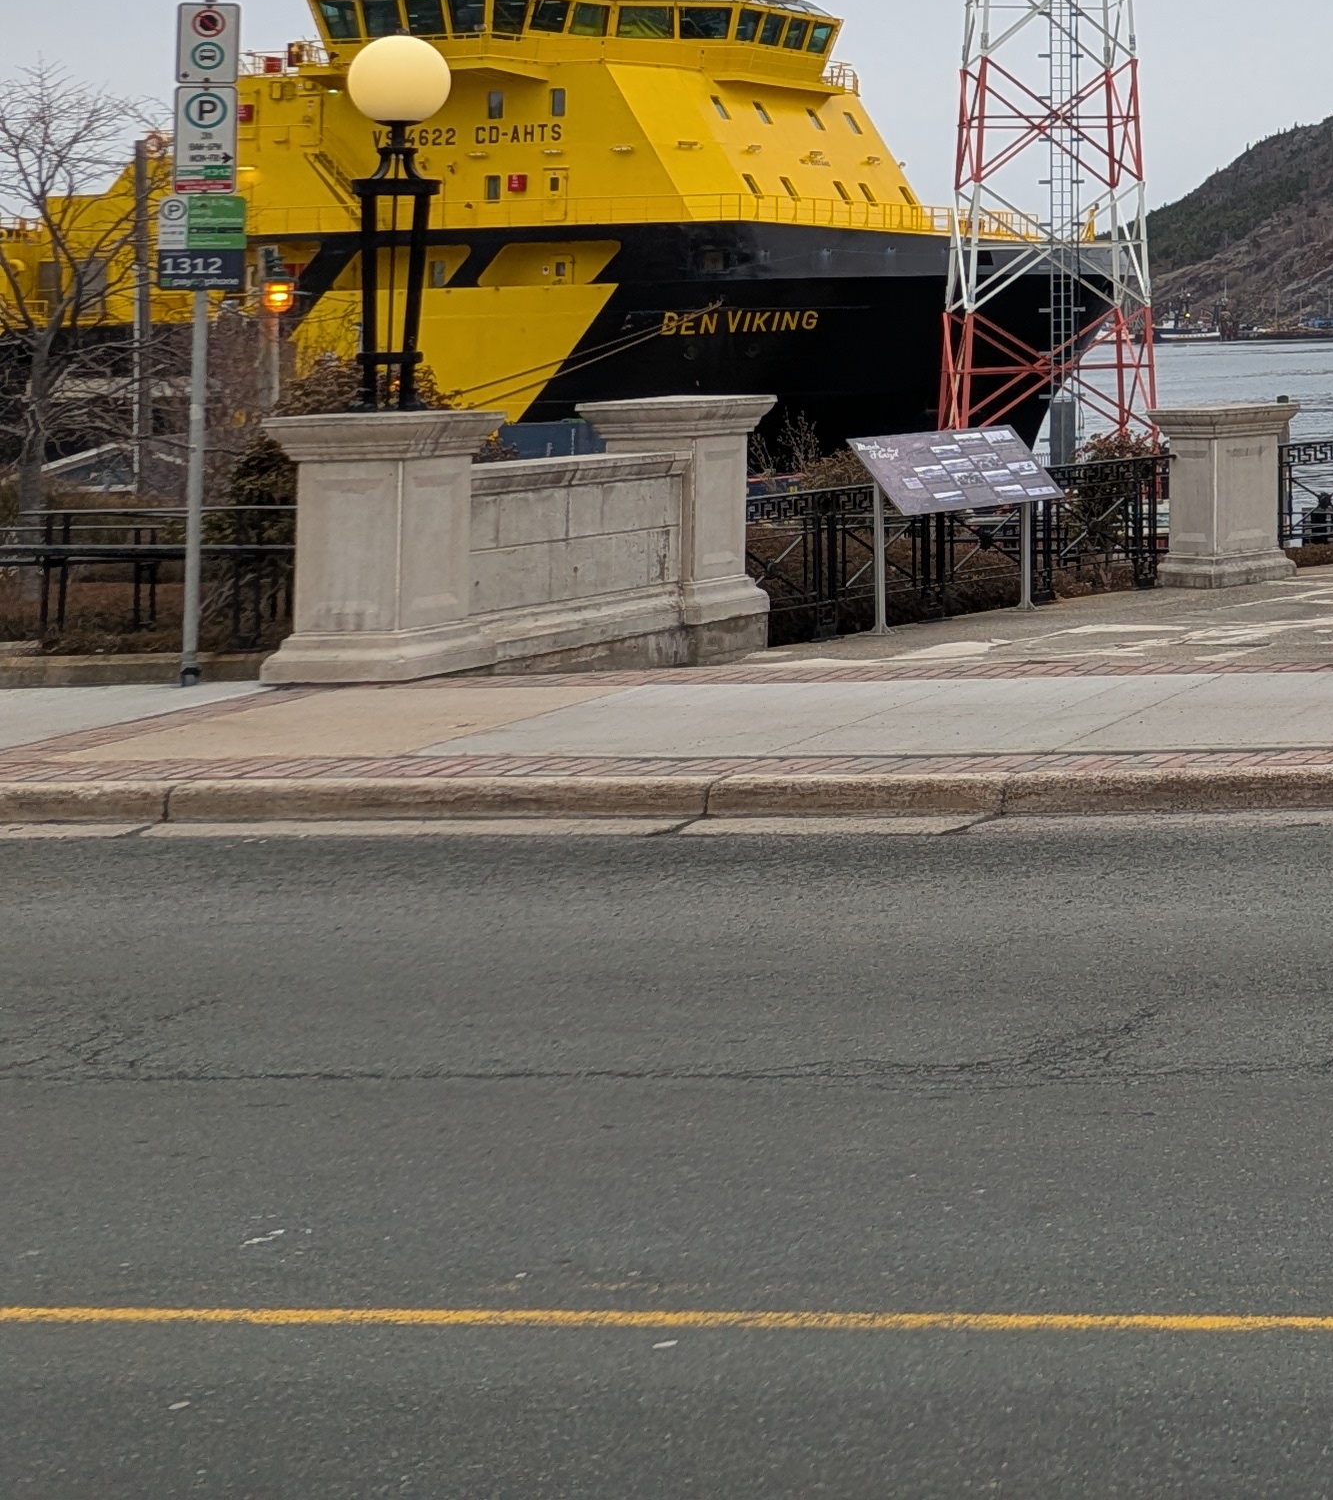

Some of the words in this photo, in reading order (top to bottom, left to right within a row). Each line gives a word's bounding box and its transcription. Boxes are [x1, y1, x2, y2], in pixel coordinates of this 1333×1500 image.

[198, 100, 218, 121] P
[372, 130, 393, 148] VS
[404, 128, 457, 147] 4622
[475, 124, 562, 144] CD-AHTS
[161, 257, 223, 274] 1312
[661, 311, 719, 336] BEN
[727, 310, 819, 333] VIKING
